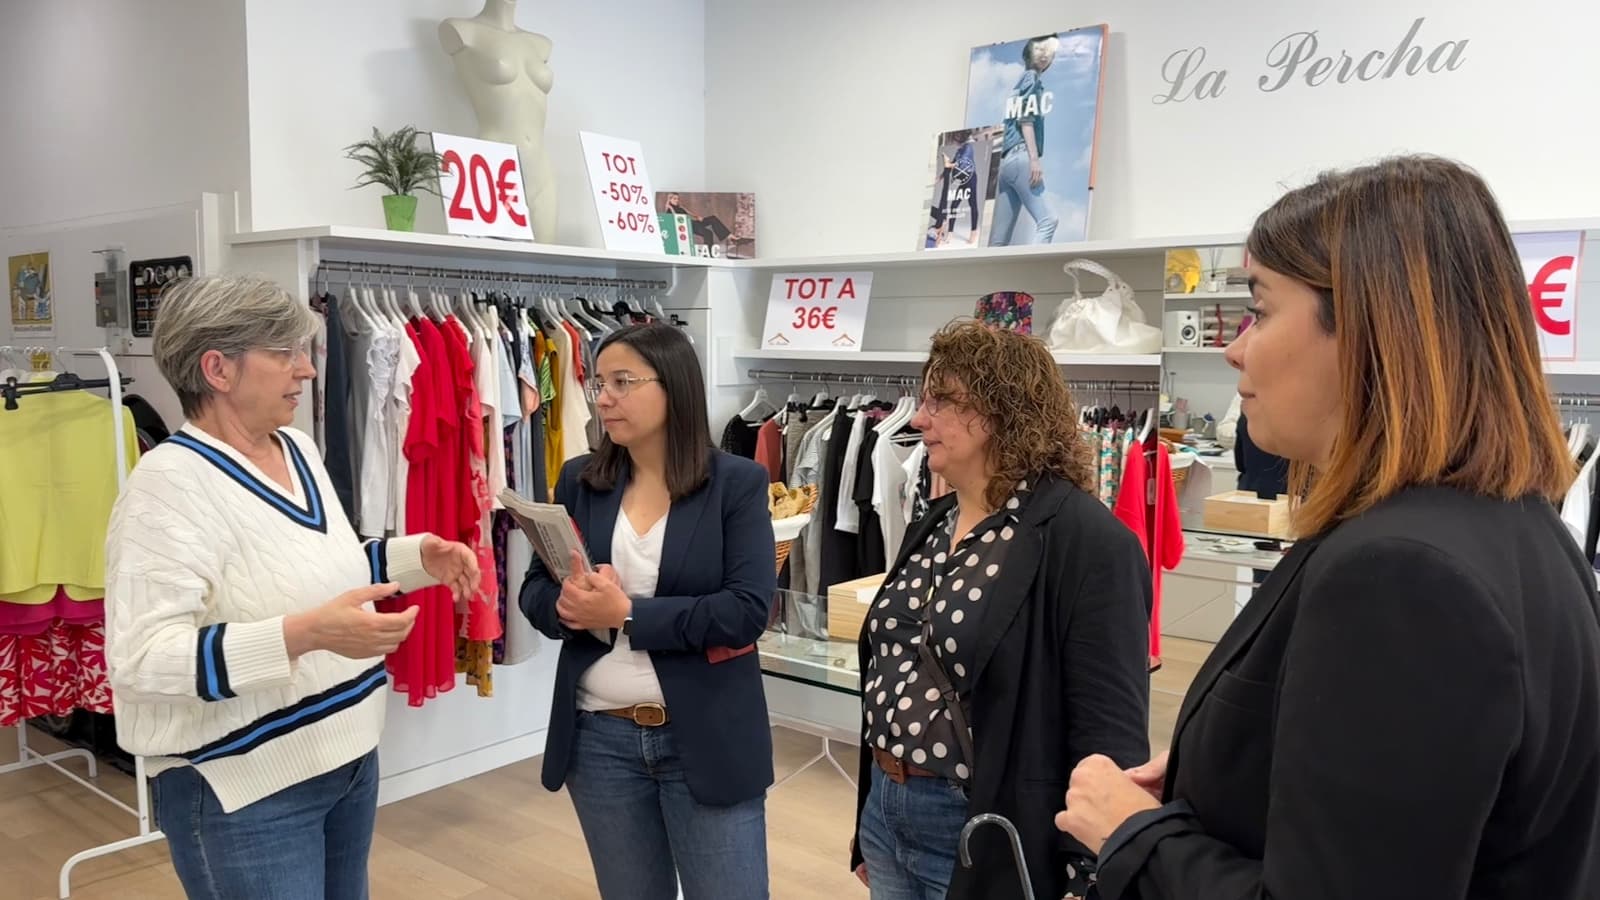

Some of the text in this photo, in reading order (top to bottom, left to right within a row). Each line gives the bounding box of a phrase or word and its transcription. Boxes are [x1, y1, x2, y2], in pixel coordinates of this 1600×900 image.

[1152, 16, 1471, 105] La Percha
[1005, 91, 1054, 120] MAC
[602, 152, 636, 175] TOT
[441, 149, 528, 228] 20€
[601, 182, 648, 205] -50%
[947, 187, 972, 201] MAC
[608, 211, 655, 234] -60%
[784, 277, 856, 300] TOT A
[792, 306, 838, 330] 36€
